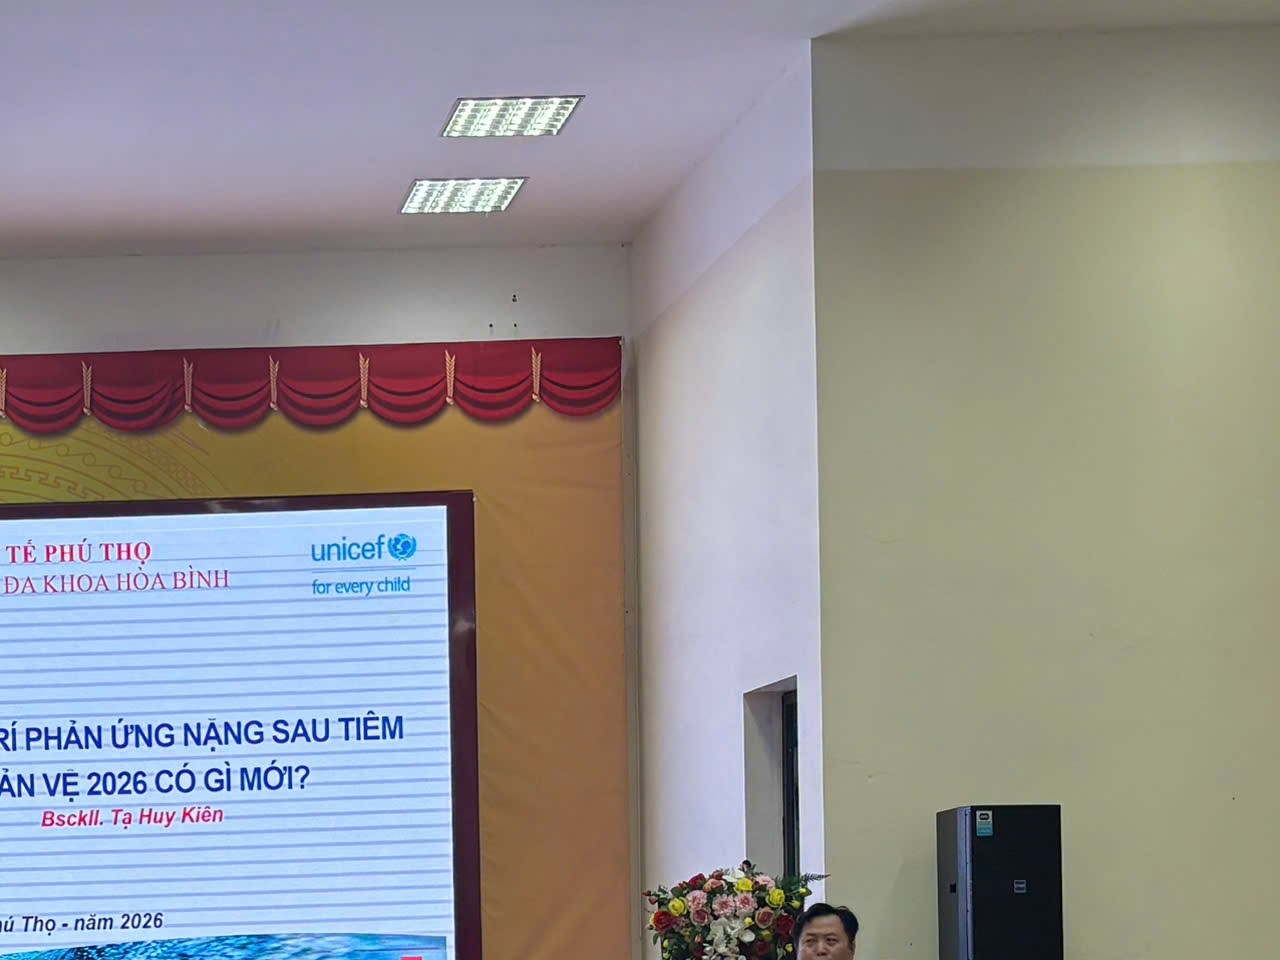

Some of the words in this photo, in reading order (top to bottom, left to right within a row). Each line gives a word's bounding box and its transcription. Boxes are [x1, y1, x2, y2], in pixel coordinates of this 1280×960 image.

[6, 540, 37, 563] TẾ
[45, 538, 92, 563] PHÚ
[99, 541, 152, 565] THỌ
[311, 534, 385, 561] unicef
[5, 575, 37, 595] ĐA
[43, 574, 110, 594] KHOA
[117, 567, 167, 592] HÒA
[172, 565, 229, 590] BÌNH
[312, 579, 332, 595] for
[334, 580, 374, 597] every
[376, 576, 411, 593] child
[26, 719, 102, 751] PHẢN
[111, 718, 175, 749] ỨNG
[183, 717, 265, 752] NẶNG
[272, 718, 330, 744] SAU
[338, 710, 404, 741] TIÊM
[42, 769, 79, 803] VỆ
[87, 770, 148, 796] 2026
[154, 763, 197, 794] CÓ
[203, 761, 232, 793] GÌ
[240, 759, 311, 791] MỚI?
[111, 809, 133, 829] Tạ
[139, 808, 176, 829] Huy
[181, 806, 224, 823] Kiên
[22, 916, 56, 936] Thọ
[74, 913, 114, 931] năm
[120, 912, 165, 930] 2026
